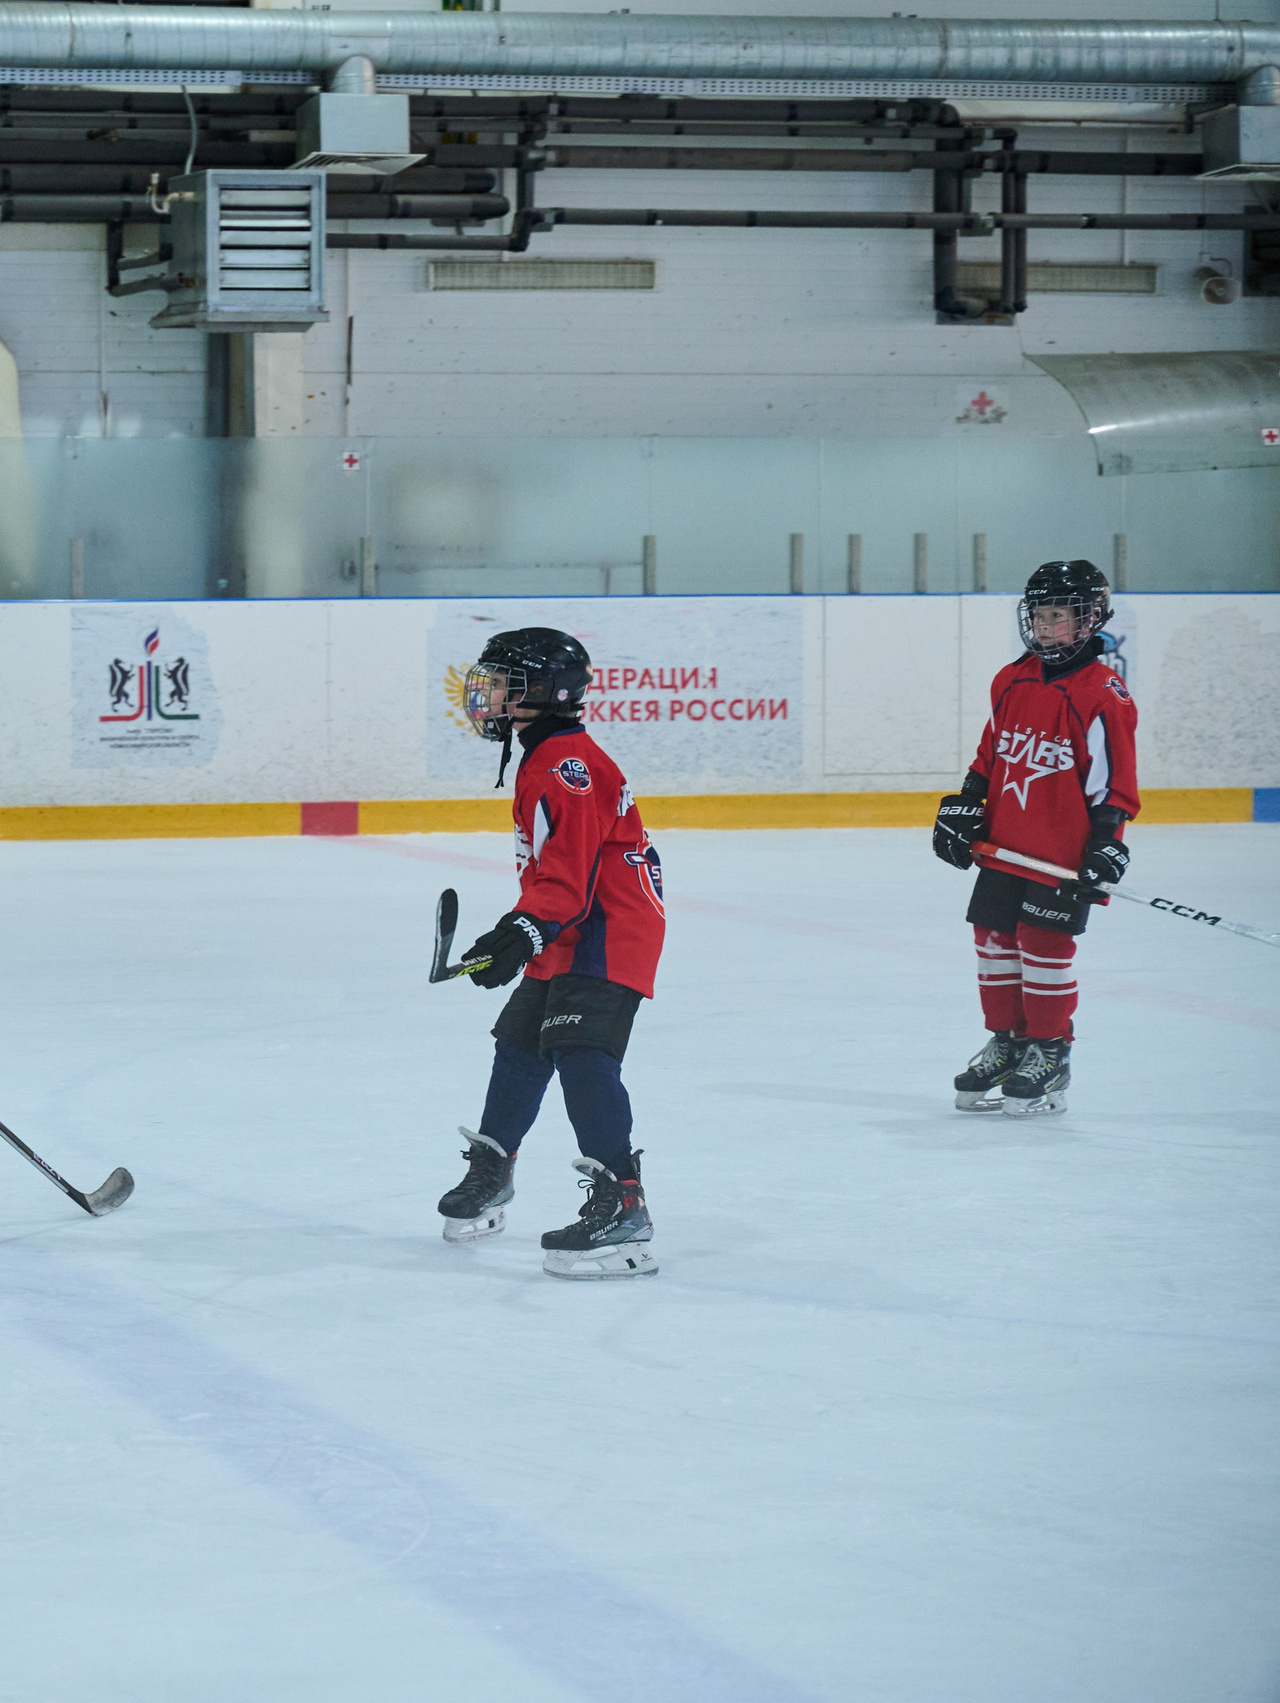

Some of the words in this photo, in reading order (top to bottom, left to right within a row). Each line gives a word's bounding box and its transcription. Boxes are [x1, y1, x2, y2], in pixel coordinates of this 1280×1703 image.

[1028, 588, 1048, 596] CCM
[521, 659, 543, 669] CCM
[586, 666, 718, 695] ДЕРАЦИЯ
[580, 699, 659, 722] ККЕЯ
[670, 697, 788, 722] РОССИИ
[997, 729, 1075, 771] STARS
[939, 805, 985, 817] BAUE
[1021, 901, 1072, 923] BAUER
[1150, 897, 1222, 926] CCM
[513, 916, 544, 957] PRIME
[589, 1220, 619, 1241] BAUER
